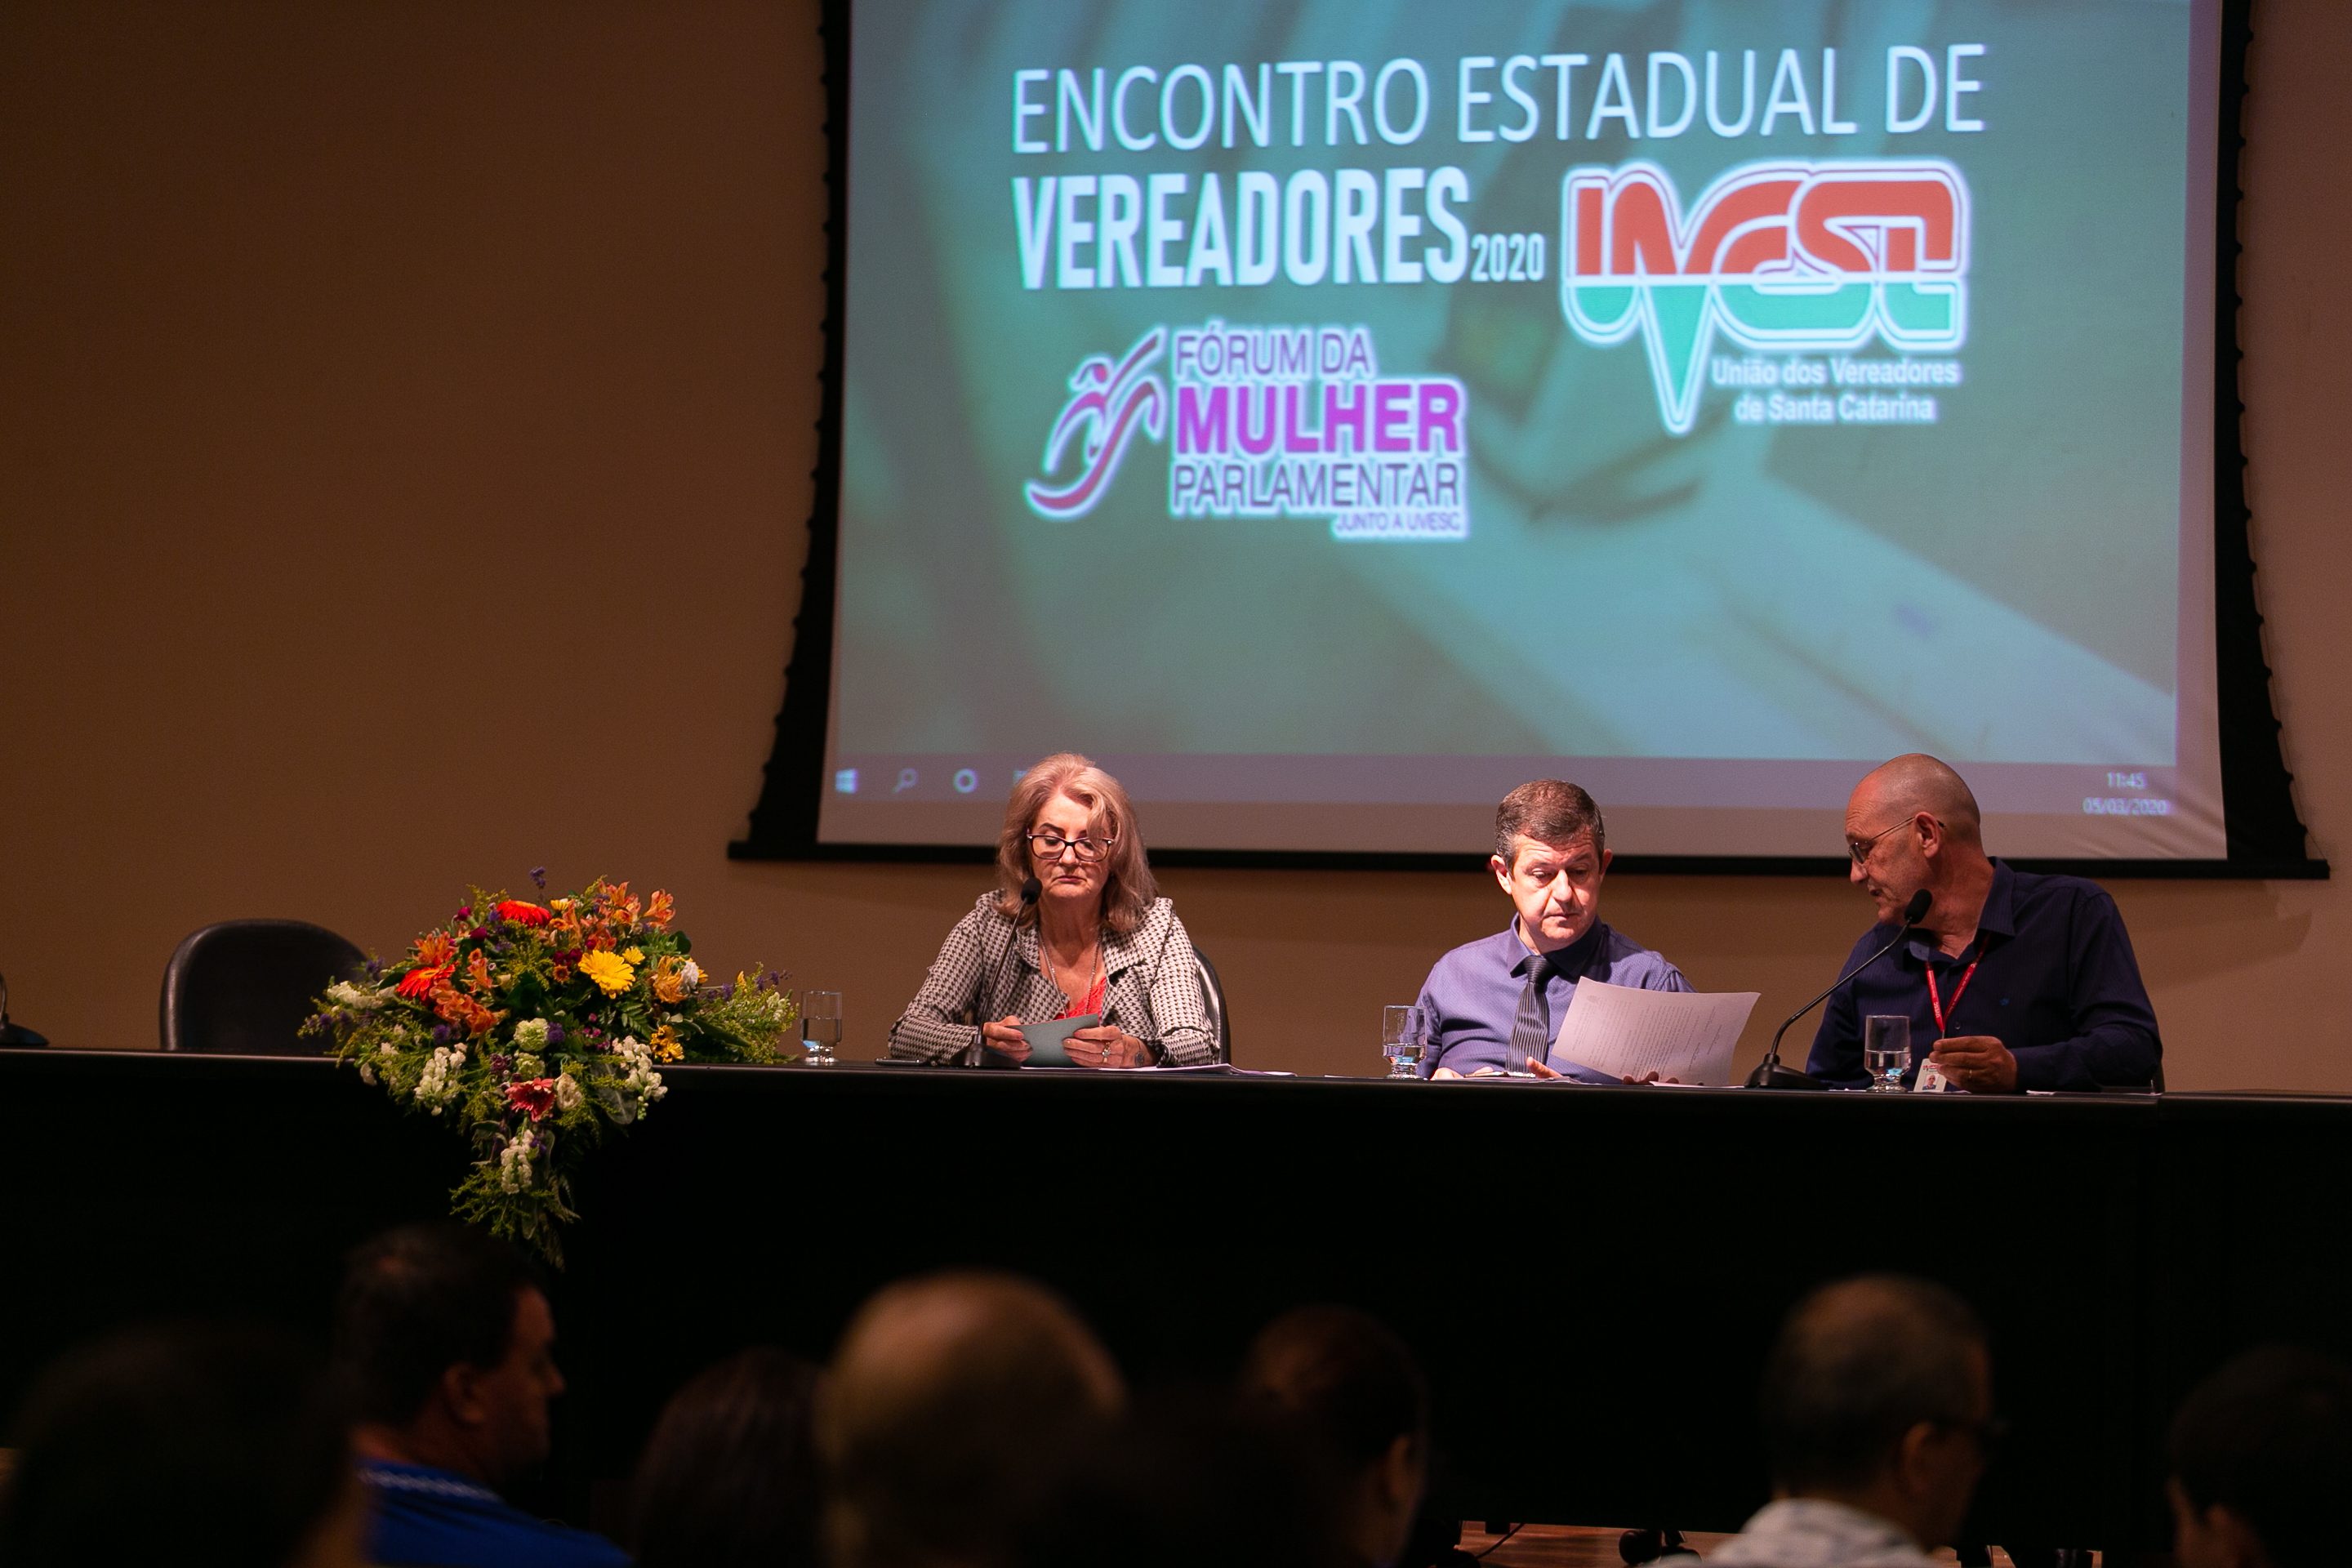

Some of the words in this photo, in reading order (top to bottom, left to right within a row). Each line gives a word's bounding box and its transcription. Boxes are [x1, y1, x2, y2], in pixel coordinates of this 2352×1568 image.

[1013, 58, 1429, 154] ENCONTRO
[1458, 47, 1857, 143] ESTADUAL
[1886, 44, 1984, 134] DE
[1012, 166, 1469, 290] VEREADORES
[1471, 232, 1545, 283] 2020
[1174, 321, 1308, 376] FÓRUM
[1321, 332, 1372, 375] DA
[1711, 356, 1777, 385] União
[1783, 356, 1827, 385] dos
[1830, 354, 1960, 384] Vereadores
[1177, 384, 1460, 455] MULHER
[1733, 390, 1764, 421] de
[1768, 390, 1834, 421] Santa
[1838, 388, 1936, 421] Catarina
[1174, 461, 1459, 508] PARLAMENTAR
[1336, 512, 1388, 531] JUNTO
[1392, 512, 1402, 529] A
[1406, 511, 1460, 531] UVESC
